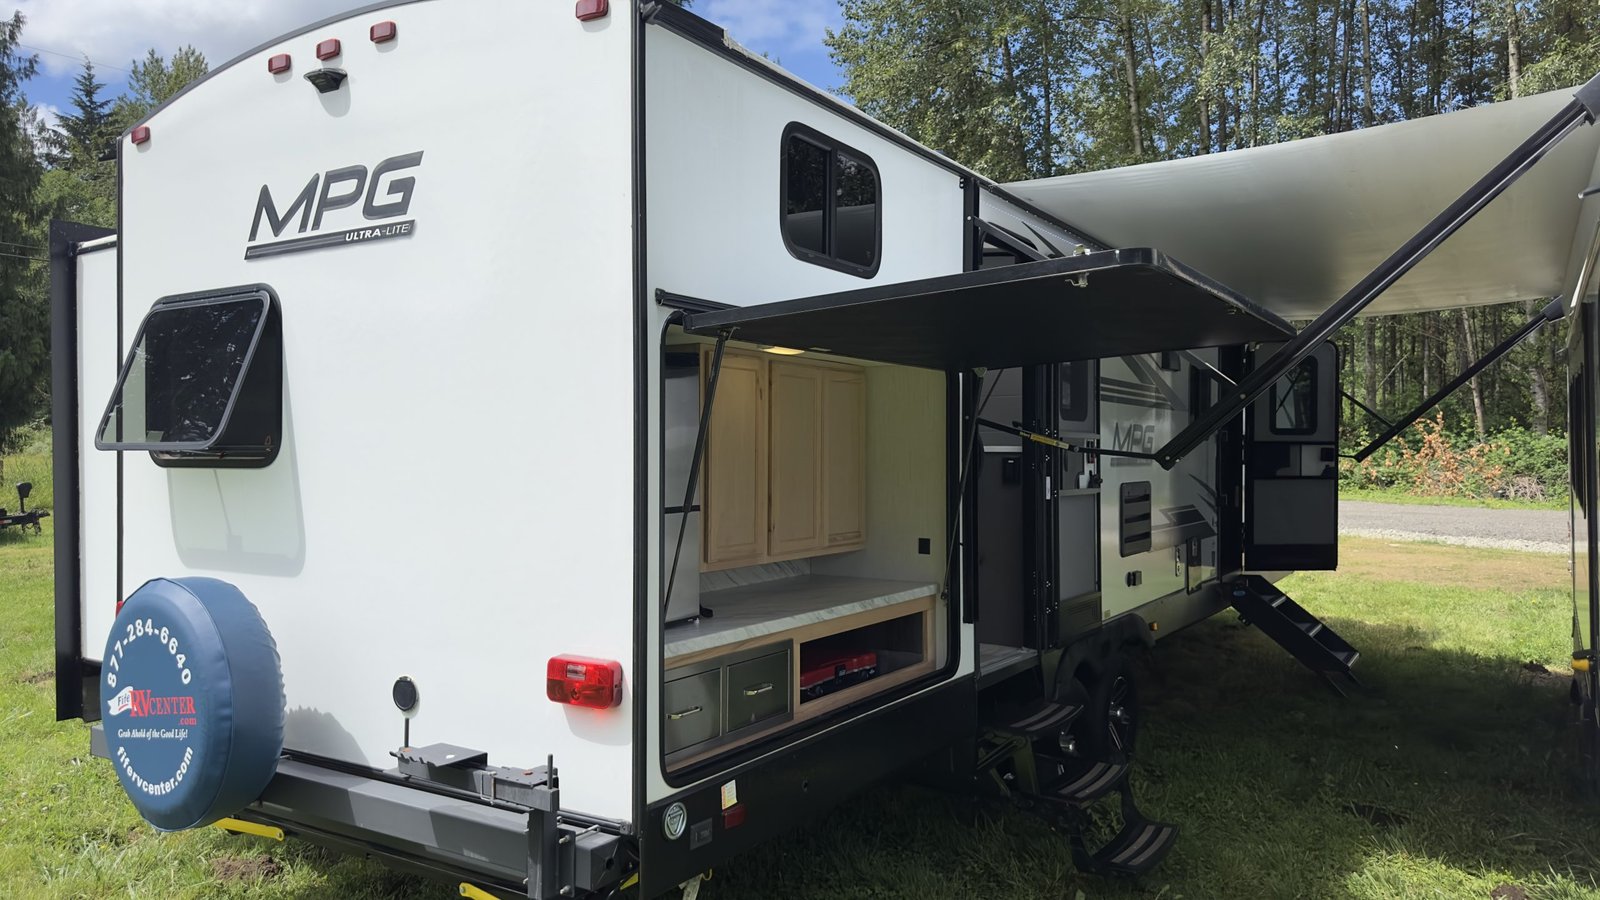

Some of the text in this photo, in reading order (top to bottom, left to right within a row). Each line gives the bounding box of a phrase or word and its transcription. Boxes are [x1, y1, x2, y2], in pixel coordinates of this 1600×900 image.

[248, 151, 424, 242] MPG
[345, 223, 411, 241] ULTRA-LITE
[1112, 422, 1155, 454] MPG
[107, 618, 191, 688] 877-284-6640
[146, 728, 152, 740] of
[152, 728, 160, 738] the
[160, 728, 174, 738] Good
[175, 728, 188, 741] Life!
[178, 717, 197, 726] .com
[117, 746, 193, 795] fifervcenter.com
